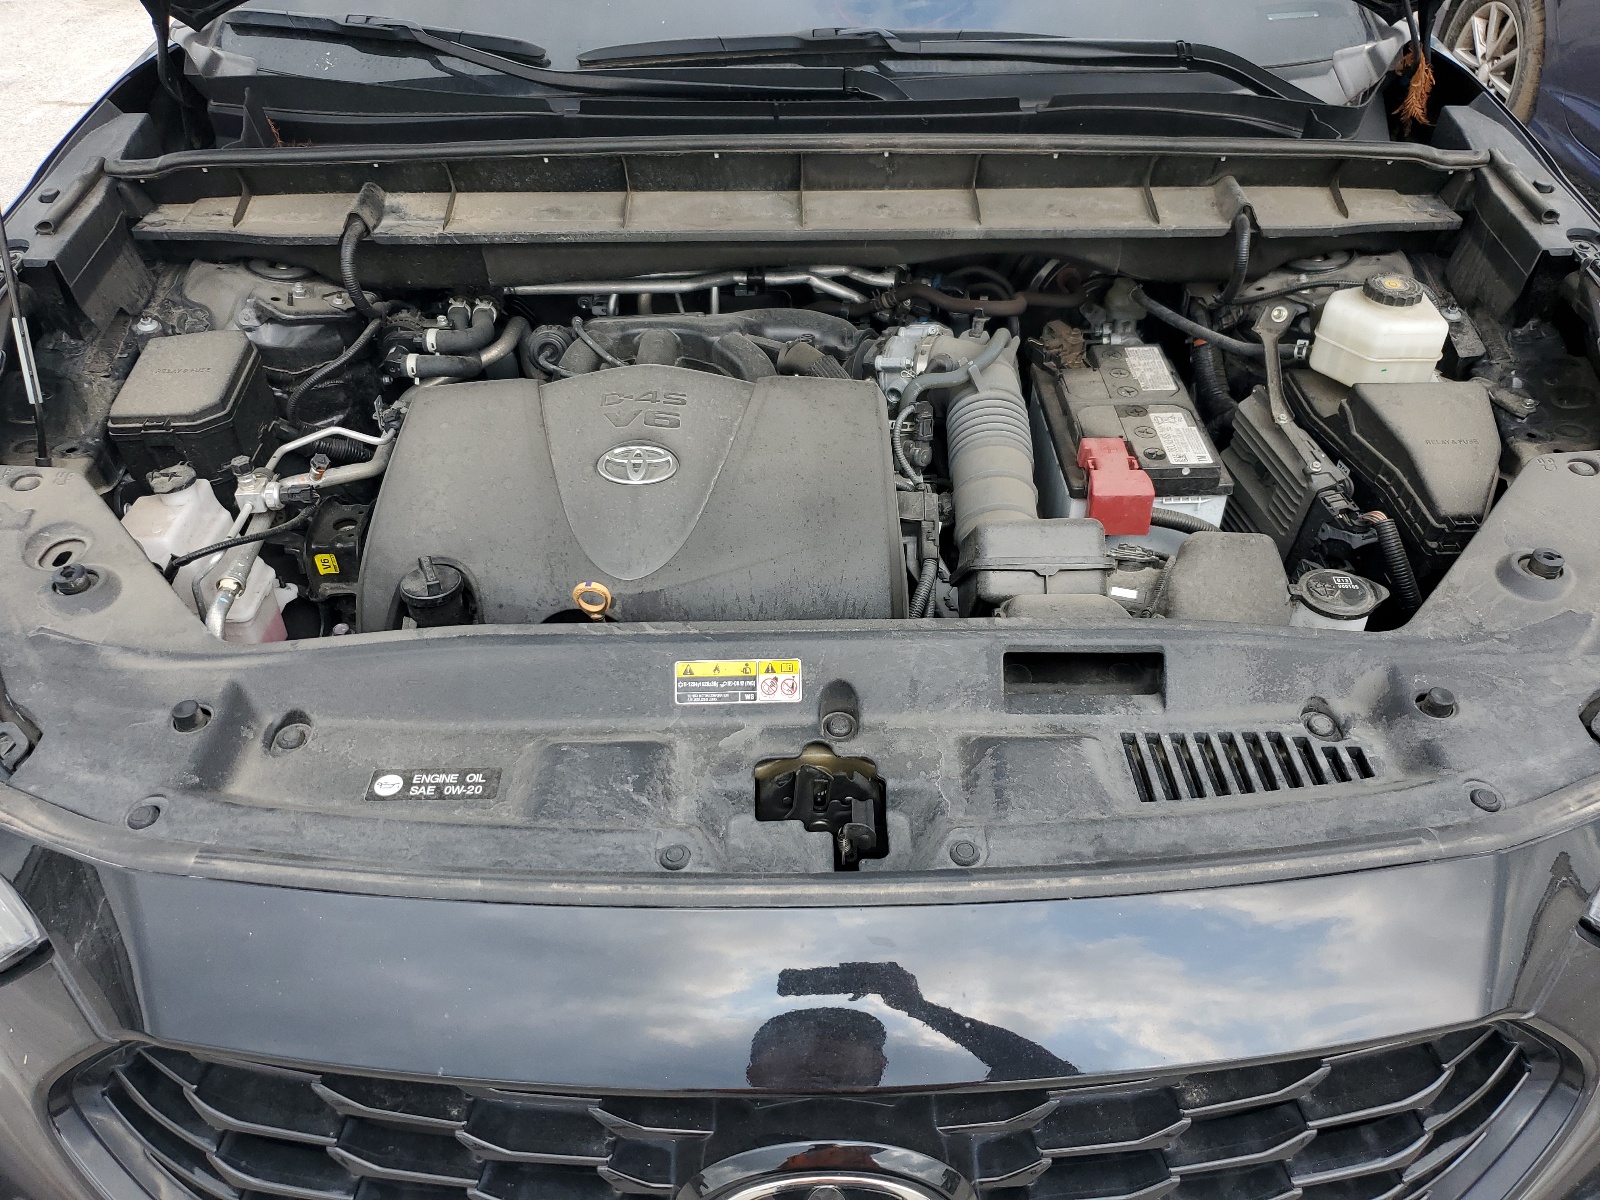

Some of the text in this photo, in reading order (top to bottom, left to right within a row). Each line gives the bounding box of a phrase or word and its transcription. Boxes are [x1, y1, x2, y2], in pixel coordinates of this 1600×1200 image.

[599, 390, 687, 406] D-4S
[603, 409, 681, 429] V6
[412, 773, 486, 783] ENGINE OIL
[409, 785, 483, 795] SAE 0W-20
